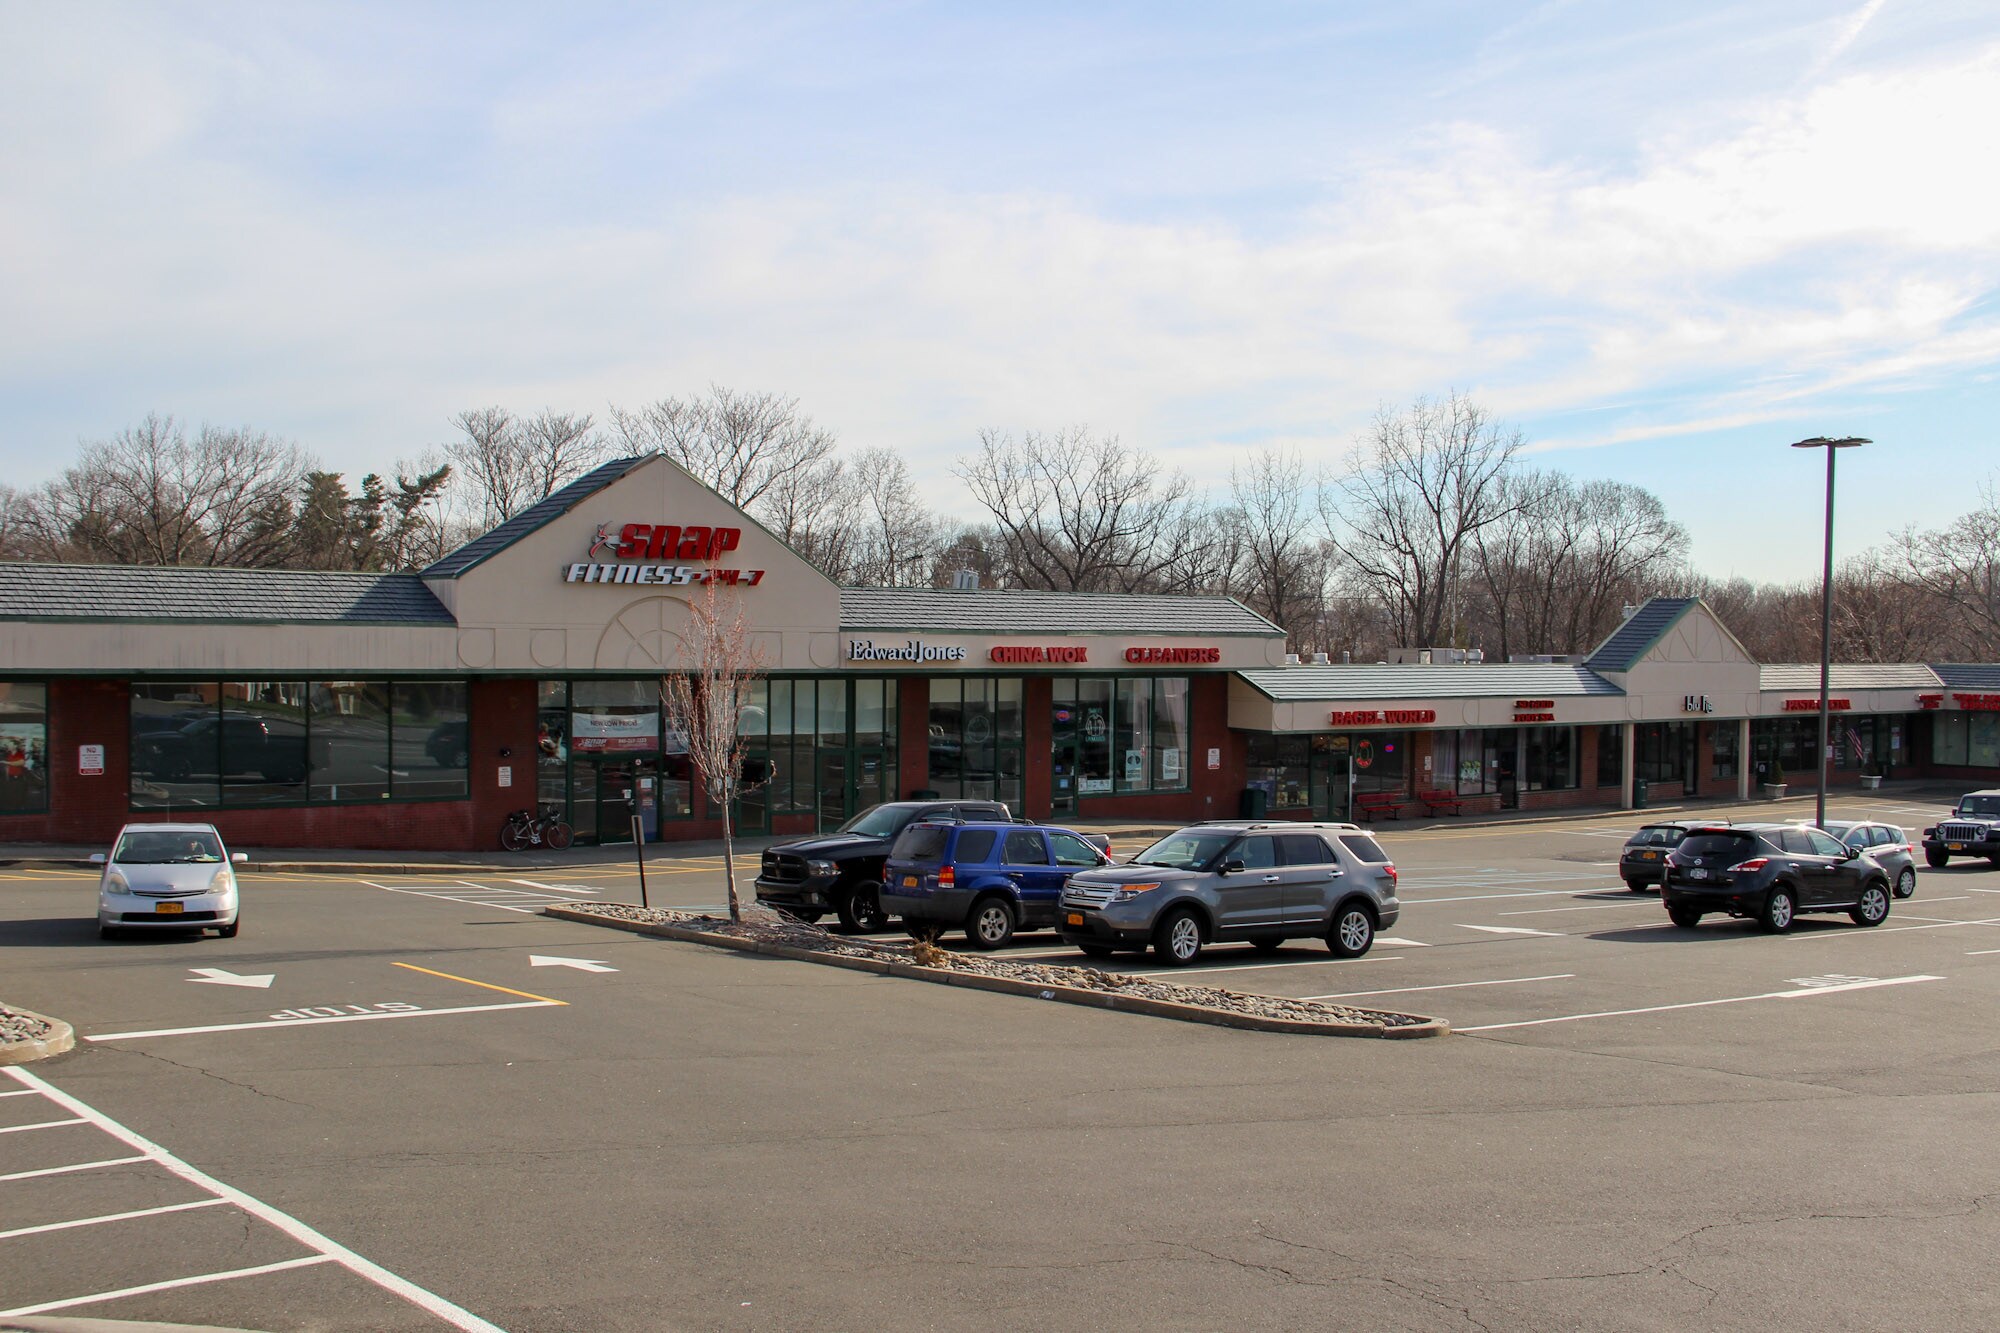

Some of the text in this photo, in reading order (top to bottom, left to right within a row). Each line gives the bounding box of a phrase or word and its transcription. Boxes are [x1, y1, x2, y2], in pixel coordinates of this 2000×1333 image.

[851, 640, 967, 663] Edward Jones
[991, 646, 1088, 663] CHINA WOK
[1126, 647, 1221, 663] CLEANERS
[1331, 710, 1436, 725] BAGEL WORLD
[269, 1002, 423, 1020] STOP
